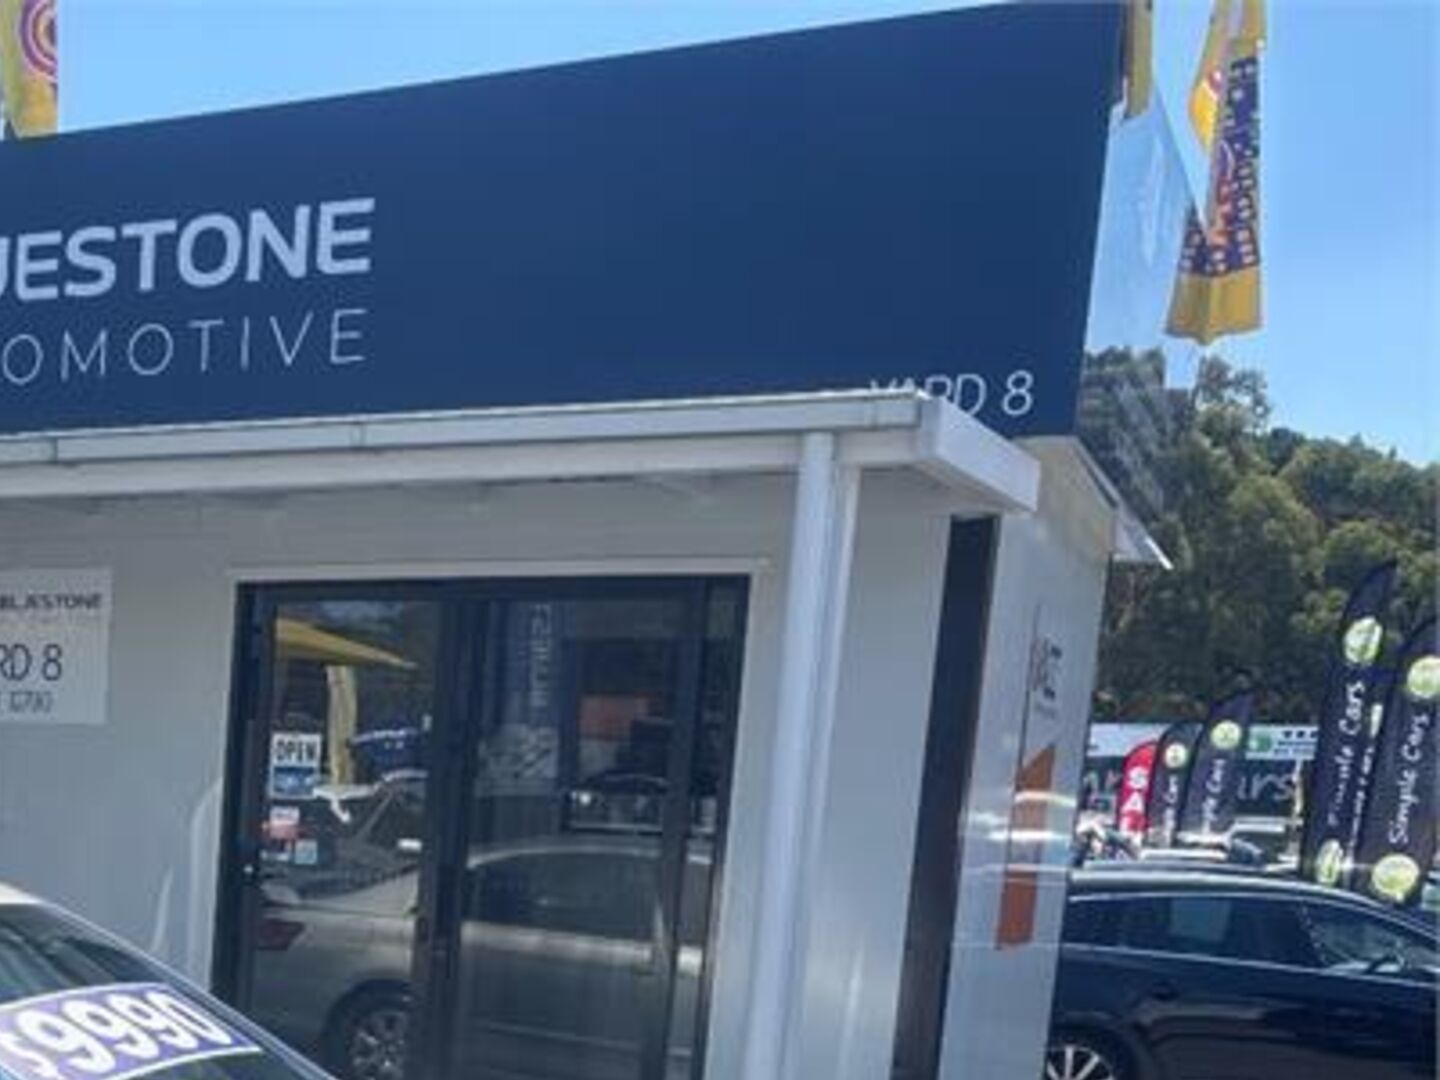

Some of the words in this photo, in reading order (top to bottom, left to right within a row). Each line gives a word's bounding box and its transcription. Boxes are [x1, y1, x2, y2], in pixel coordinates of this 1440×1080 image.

[1002, 370, 1034, 416] 8
[41, 644, 63, 681] 8
[276, 737, 317, 762] OPEN
